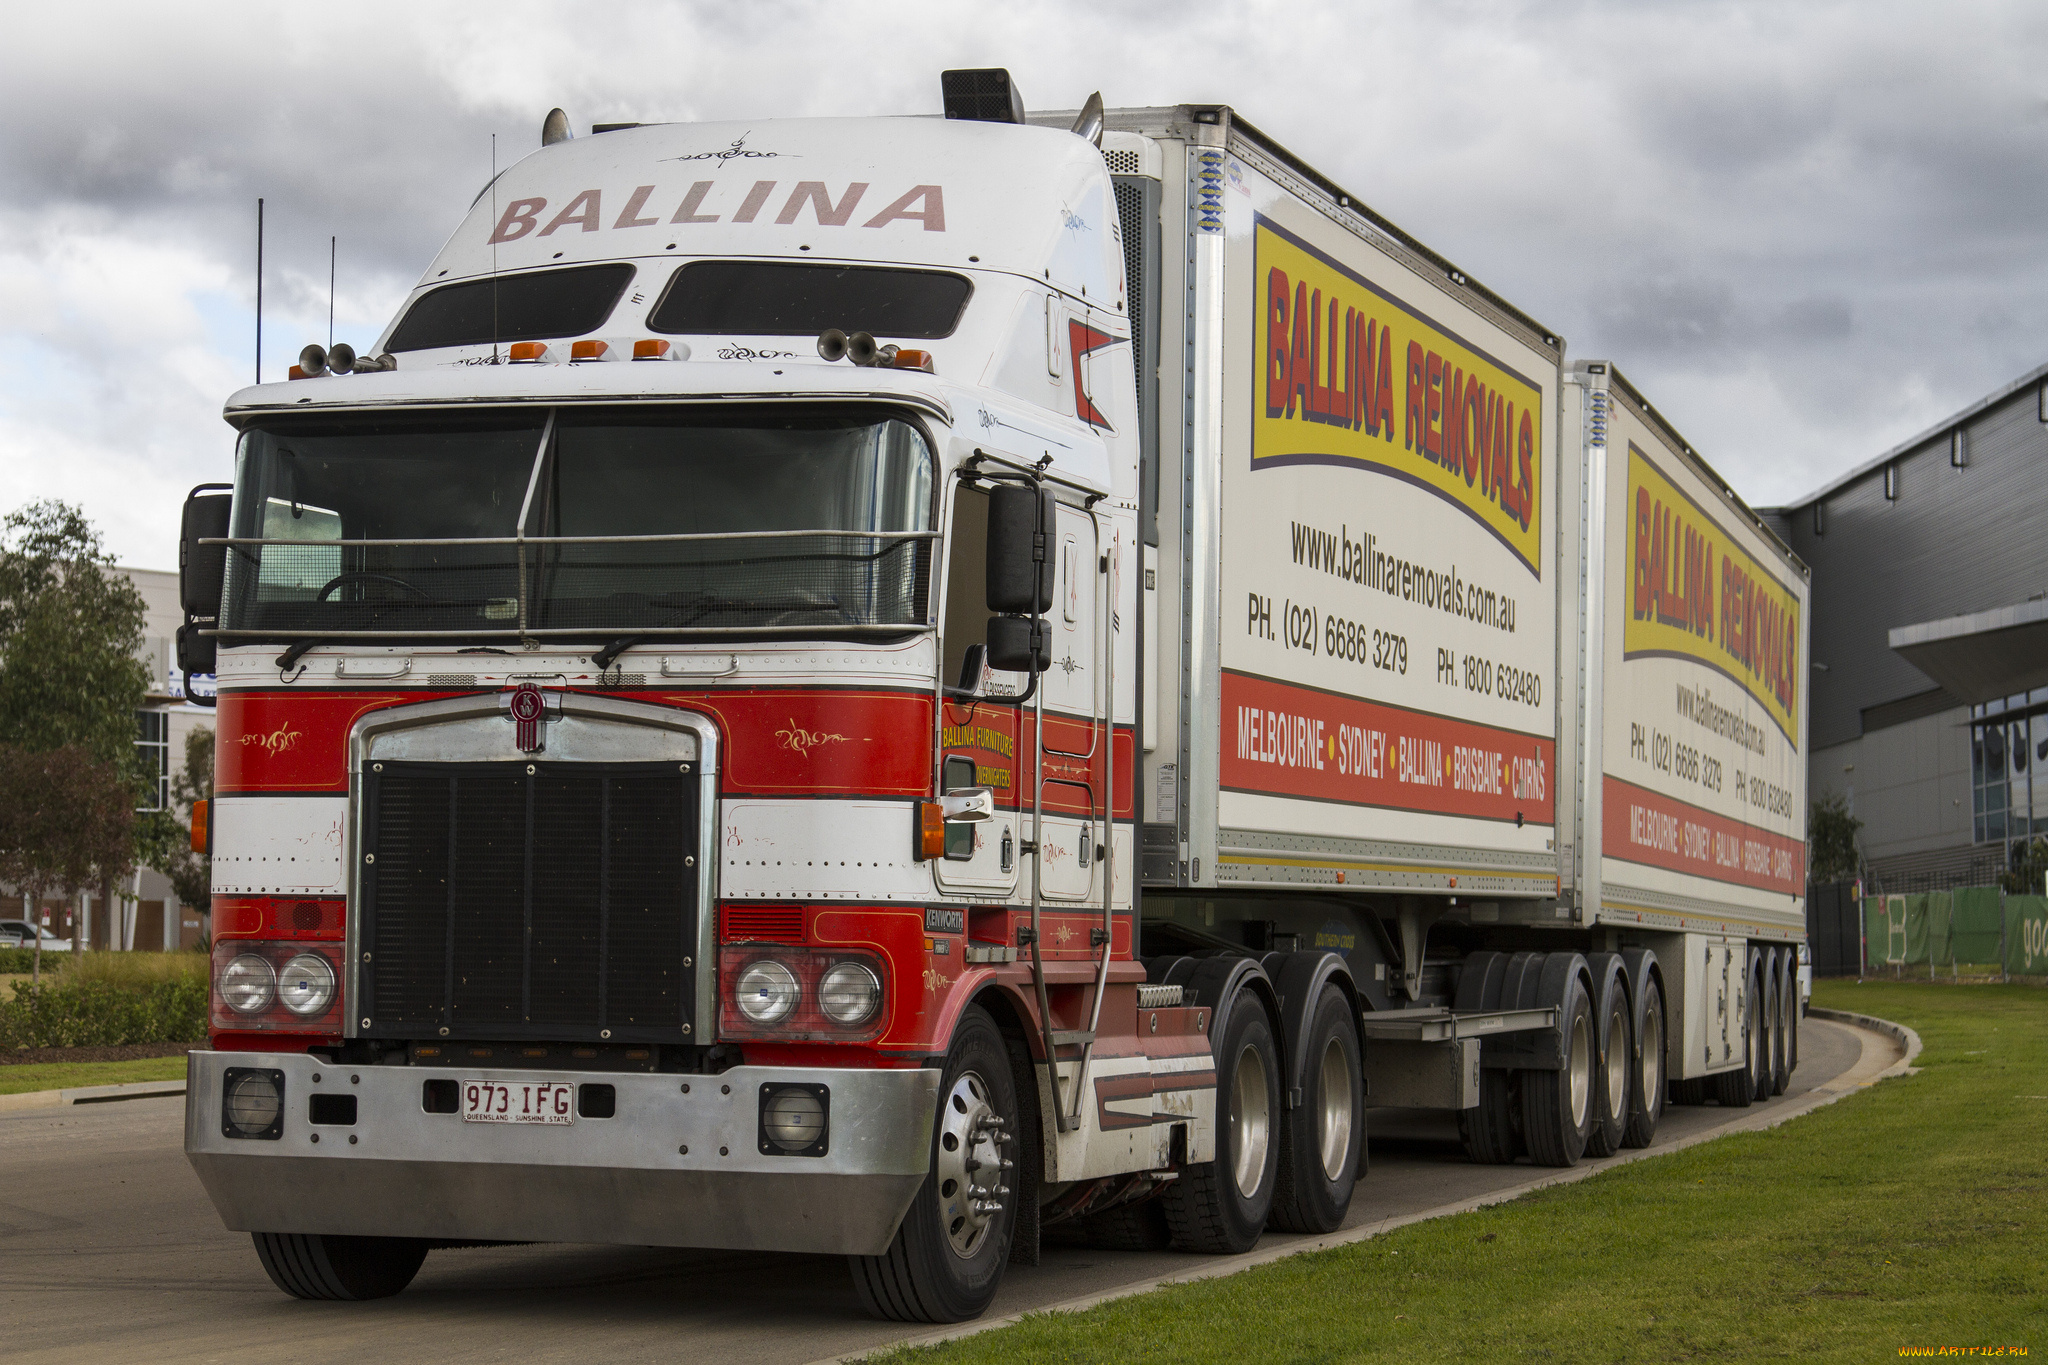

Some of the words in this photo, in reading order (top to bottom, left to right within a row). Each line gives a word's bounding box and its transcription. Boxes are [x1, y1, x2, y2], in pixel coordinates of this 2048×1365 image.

[486, 180, 947, 246] BALLINA
[1266, 266, 1394, 443] BALLINA
[1405, 339, 1534, 533] REMOVALS
[1291, 520, 1515, 633] www.ballinaremovals.com.au
[1633, 484, 1714, 642] BALLINA
[1720, 553, 1795, 719] REMOVALS
[1248, 592, 1275, 641] PH.
[1283, 598, 1318, 656] (02)
[1325, 615, 1366, 664] 6686
[1373, 628, 1407, 675] 3279
[1437, 647, 1458, 687] PH.
[1462, 654, 1492, 696] 1800
[1496, 663, 1541, 708] 632480
[520, 705, 534, 716] W
[523, 694, 532, 706] K
[1676, 682, 1765, 757] www.ballinaremovals.com.au
[943, 726, 974, 750] BALLINA
[976, 726, 1013, 760] FURNITURE
[976, 765, 1011, 789] OVERNIGHTERS
[1237, 705, 1324, 771] MELBOURNE
[1338, 723, 1387, 779] SYDNEY
[1399, 736, 1442, 787] BALLINA
[1454, 745, 1502, 795] BRISBANE
[1631, 722, 1648, 763] PH.
[1652, 727, 1672, 776] (02)
[1675, 742, 1699, 784] 6686
[1702, 753, 1722, 794] 3279
[1749, 775, 1767, 810] 1800
[1768, 783, 1792, 820] 632480
[1630, 804, 1678, 854] MELBOURNE
[1684, 820, 1711, 862] SYDNEY
[1716, 831, 1740, 869] BALLINA
[1744, 839, 1770, 876] BRISBANE
[1774, 848, 1792, 882] CAIRNS
[926, 909, 964, 929] KENWORTH
[466, 1113, 509, 1121] QUEENSLAND
[549, 1115, 568, 1123] STATE
[467, 1085, 509, 1113] 973
[522, 1086, 568, 1114] IFG
